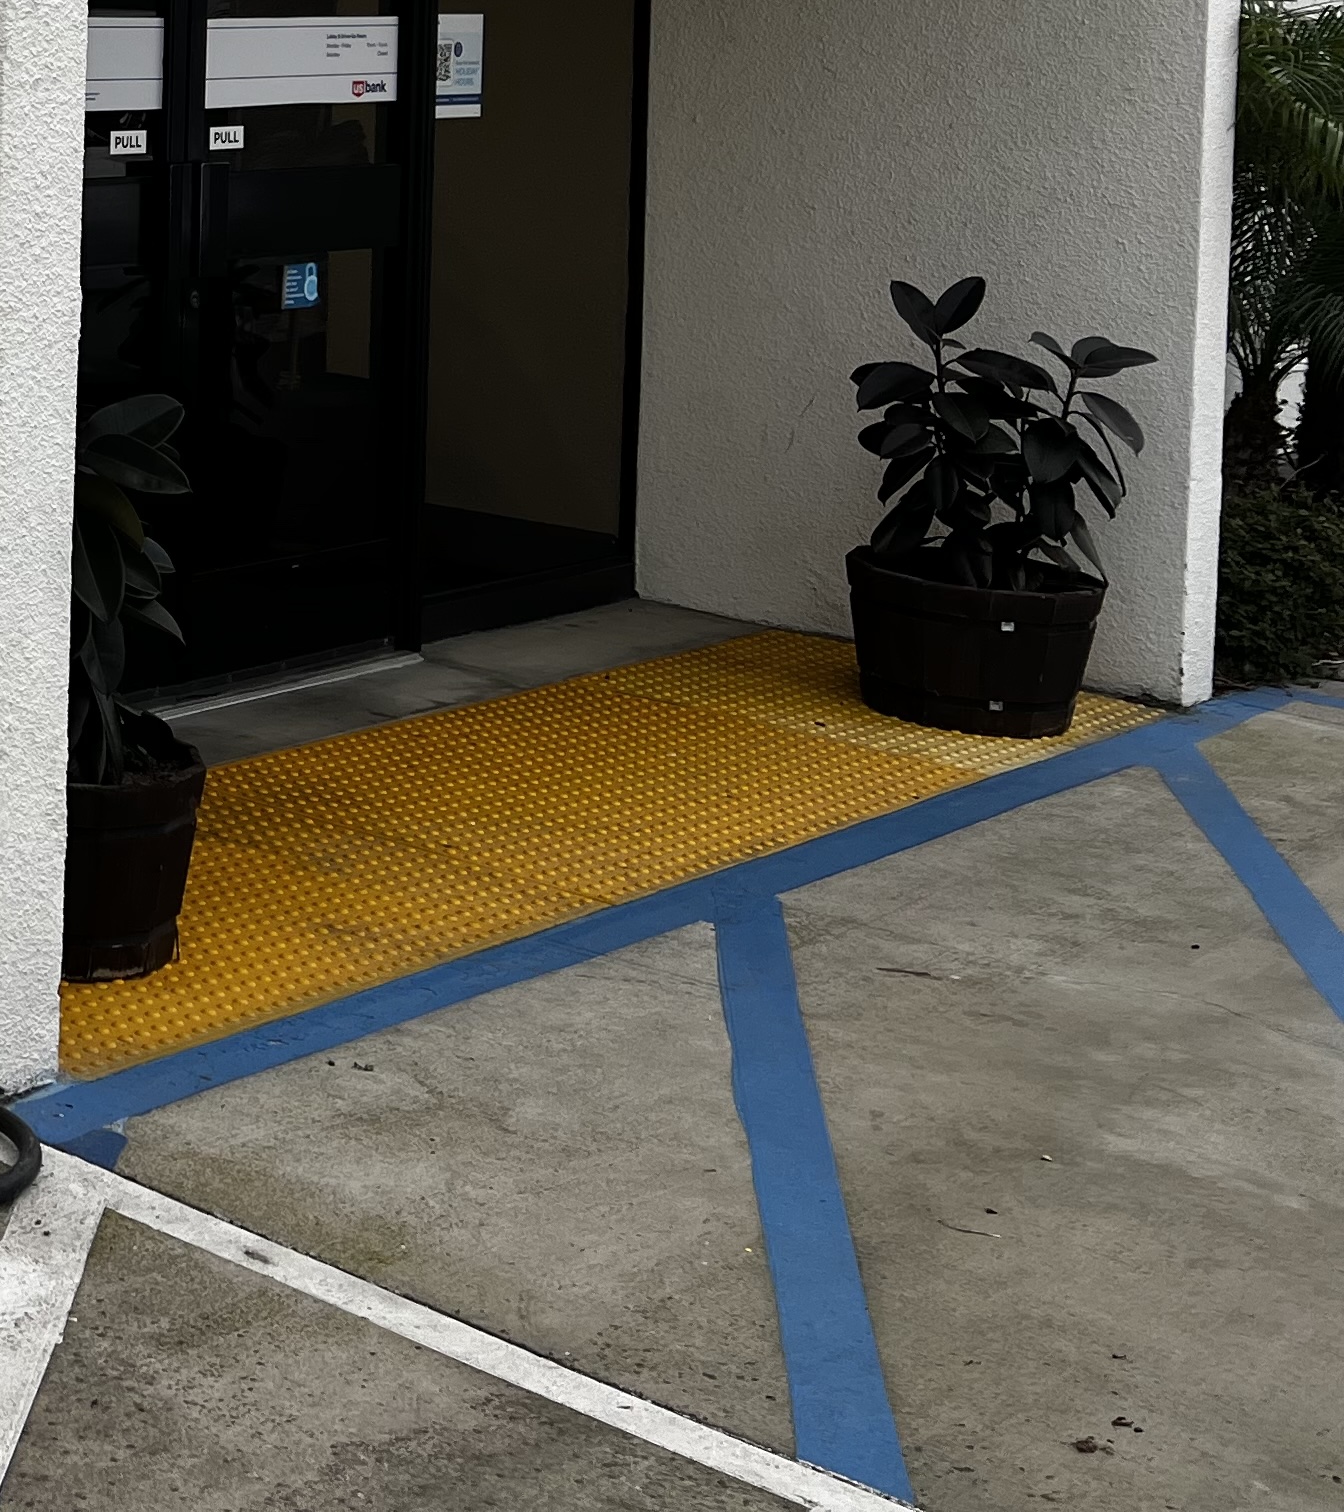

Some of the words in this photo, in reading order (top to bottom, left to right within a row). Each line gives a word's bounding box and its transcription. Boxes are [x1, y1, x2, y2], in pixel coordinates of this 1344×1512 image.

[365, 80, 387, 93] bank
[114, 135, 142, 149] PULL
[214, 130, 239, 144] PULL
